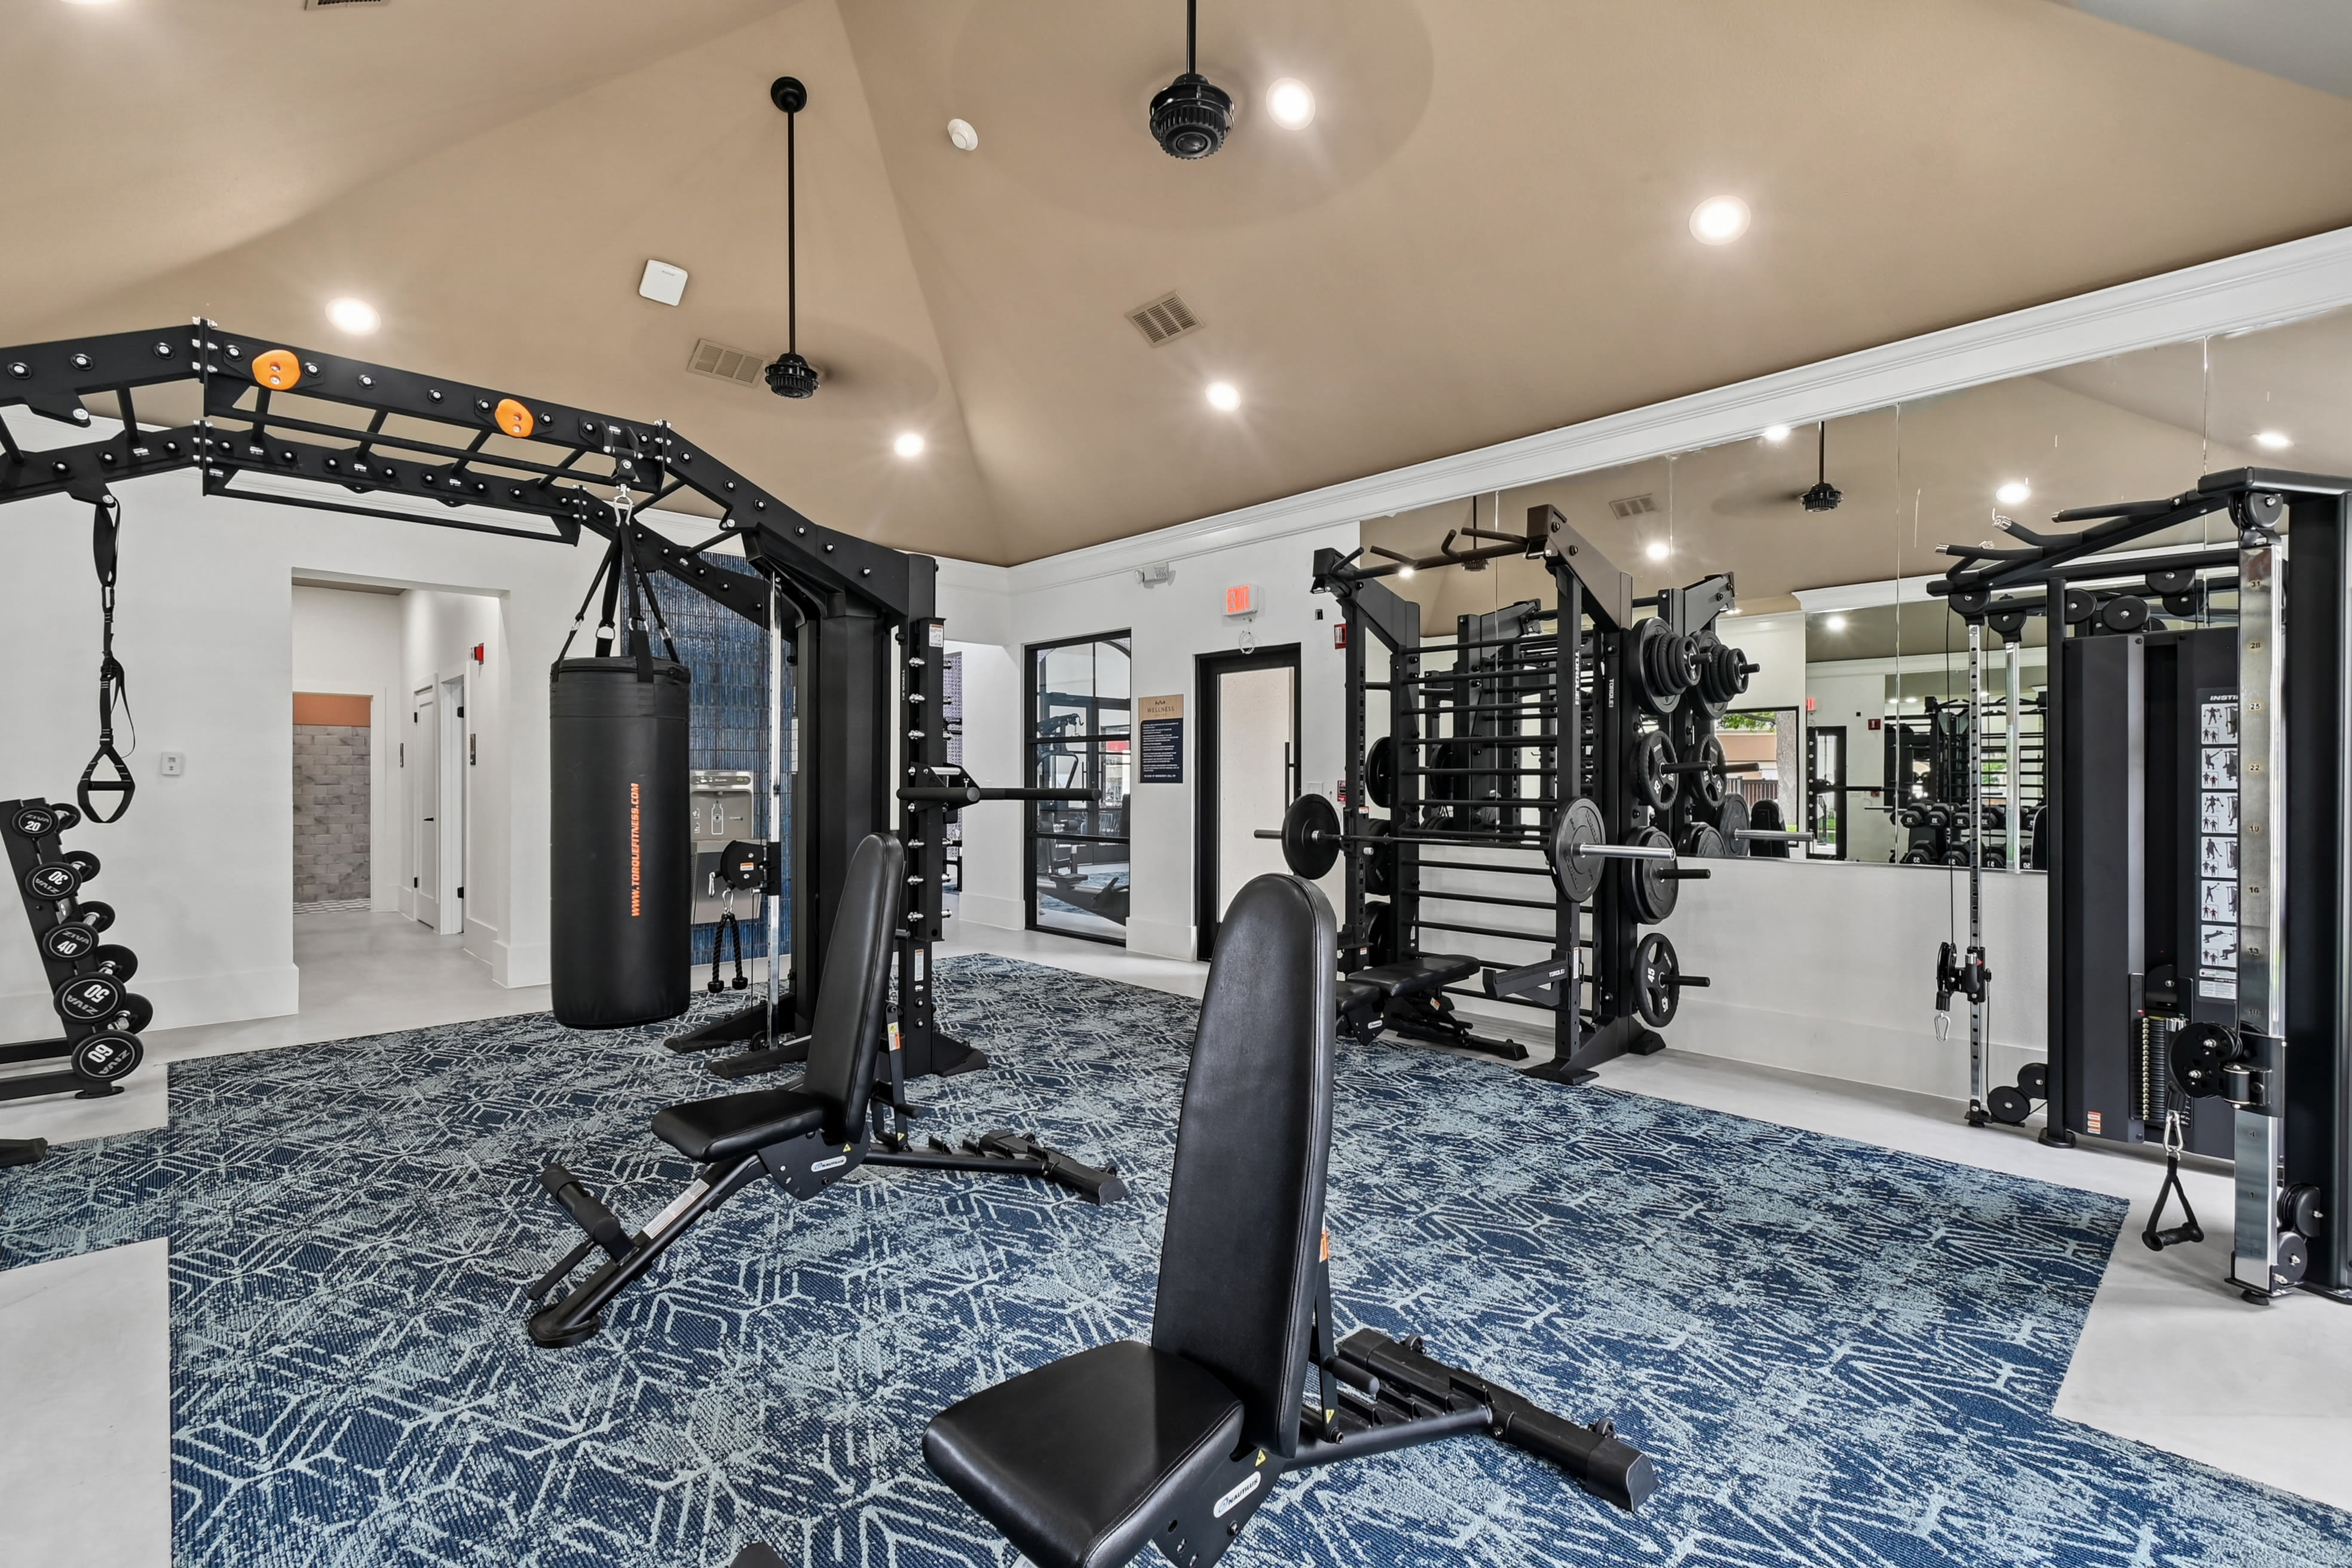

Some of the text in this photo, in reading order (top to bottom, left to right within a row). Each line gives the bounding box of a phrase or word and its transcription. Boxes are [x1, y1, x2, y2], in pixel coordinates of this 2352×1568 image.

[1227, 586, 1249, 612] EXIT
[24, 820, 41, 831] 20
[26, 814, 50, 823] ZIVA
[630, 783, 640, 916] WWW.TORQUEFITNESS.COM
[35, 878, 60, 894] ZIVA
[48, 871, 68, 885] 30
[62, 930, 90, 944] ZIVA
[57, 941, 77, 954] 40
[1647, 967, 1655, 983] 45
[83, 984, 110, 1003] 50
[66, 994, 99, 1015] ZIVA
[87, 1044, 114, 1063] 60
[97, 1049, 130, 1074] ZIVA
[1229, 1478, 1258, 1505] NAUTILUS
